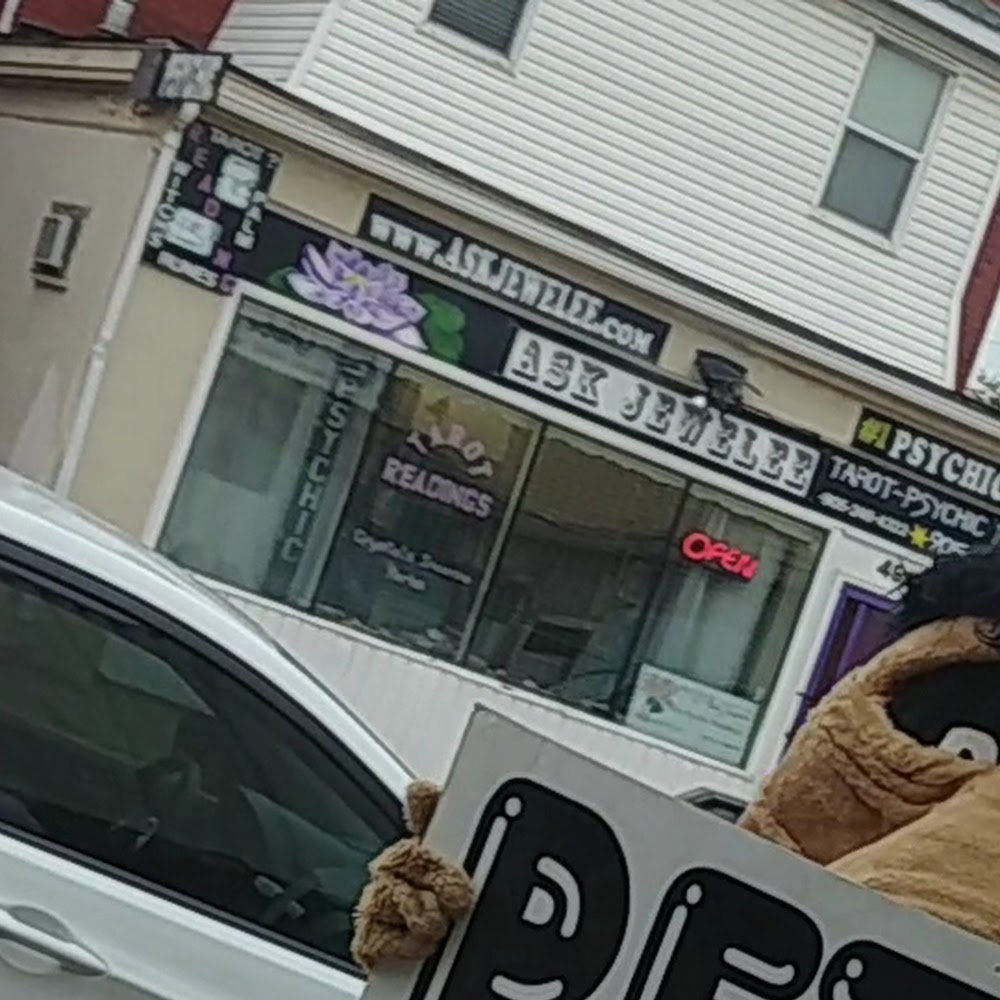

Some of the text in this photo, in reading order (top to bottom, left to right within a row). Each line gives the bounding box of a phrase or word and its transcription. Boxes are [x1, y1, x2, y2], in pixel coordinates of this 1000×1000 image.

[511, 338, 813, 491] ASK JEWELEE
[858, 416, 893, 450] #1
[406, 422, 494, 478] TAROT
[380, 456, 495, 519] READINGS
[682, 532, 762, 580] OPEN
